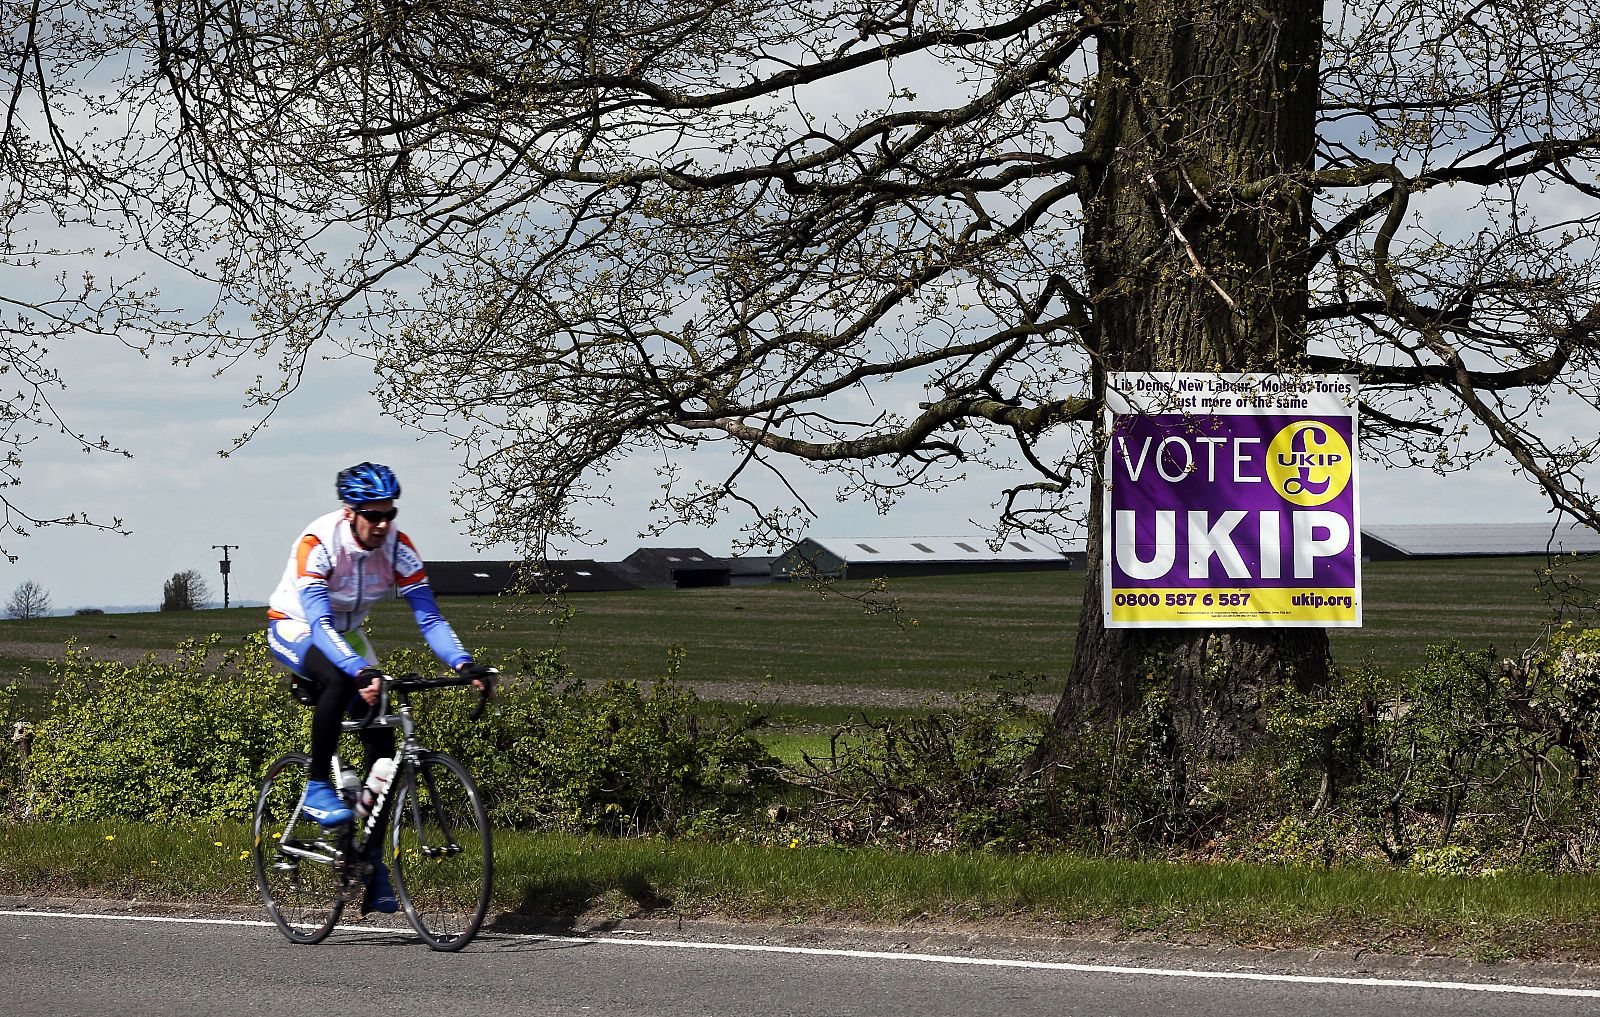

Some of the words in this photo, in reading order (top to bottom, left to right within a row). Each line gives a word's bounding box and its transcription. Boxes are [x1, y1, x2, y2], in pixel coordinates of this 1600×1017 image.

[1114, 378, 1132, 391] Lib
[1178, 380, 1204, 391] New
[1315, 380, 1351, 393] Tories
[1201, 398, 1232, 408] more
[1235, 396, 1248, 408] of
[1252, 396, 1272, 408] the
[1276, 398, 1308, 409] same
[1117, 436, 1262, 483] VOTE
[1277, 452, 1343, 467] UKIP
[1115, 510, 1350, 580] UKIP
[1114, 593, 1160, 607] 0800
[1165, 593, 1197, 607] 587
[1202, 593, 1214, 607] 6
[1218, 593, 1251, 607] 587
[1291, 592, 1352, 609] ukip.org
